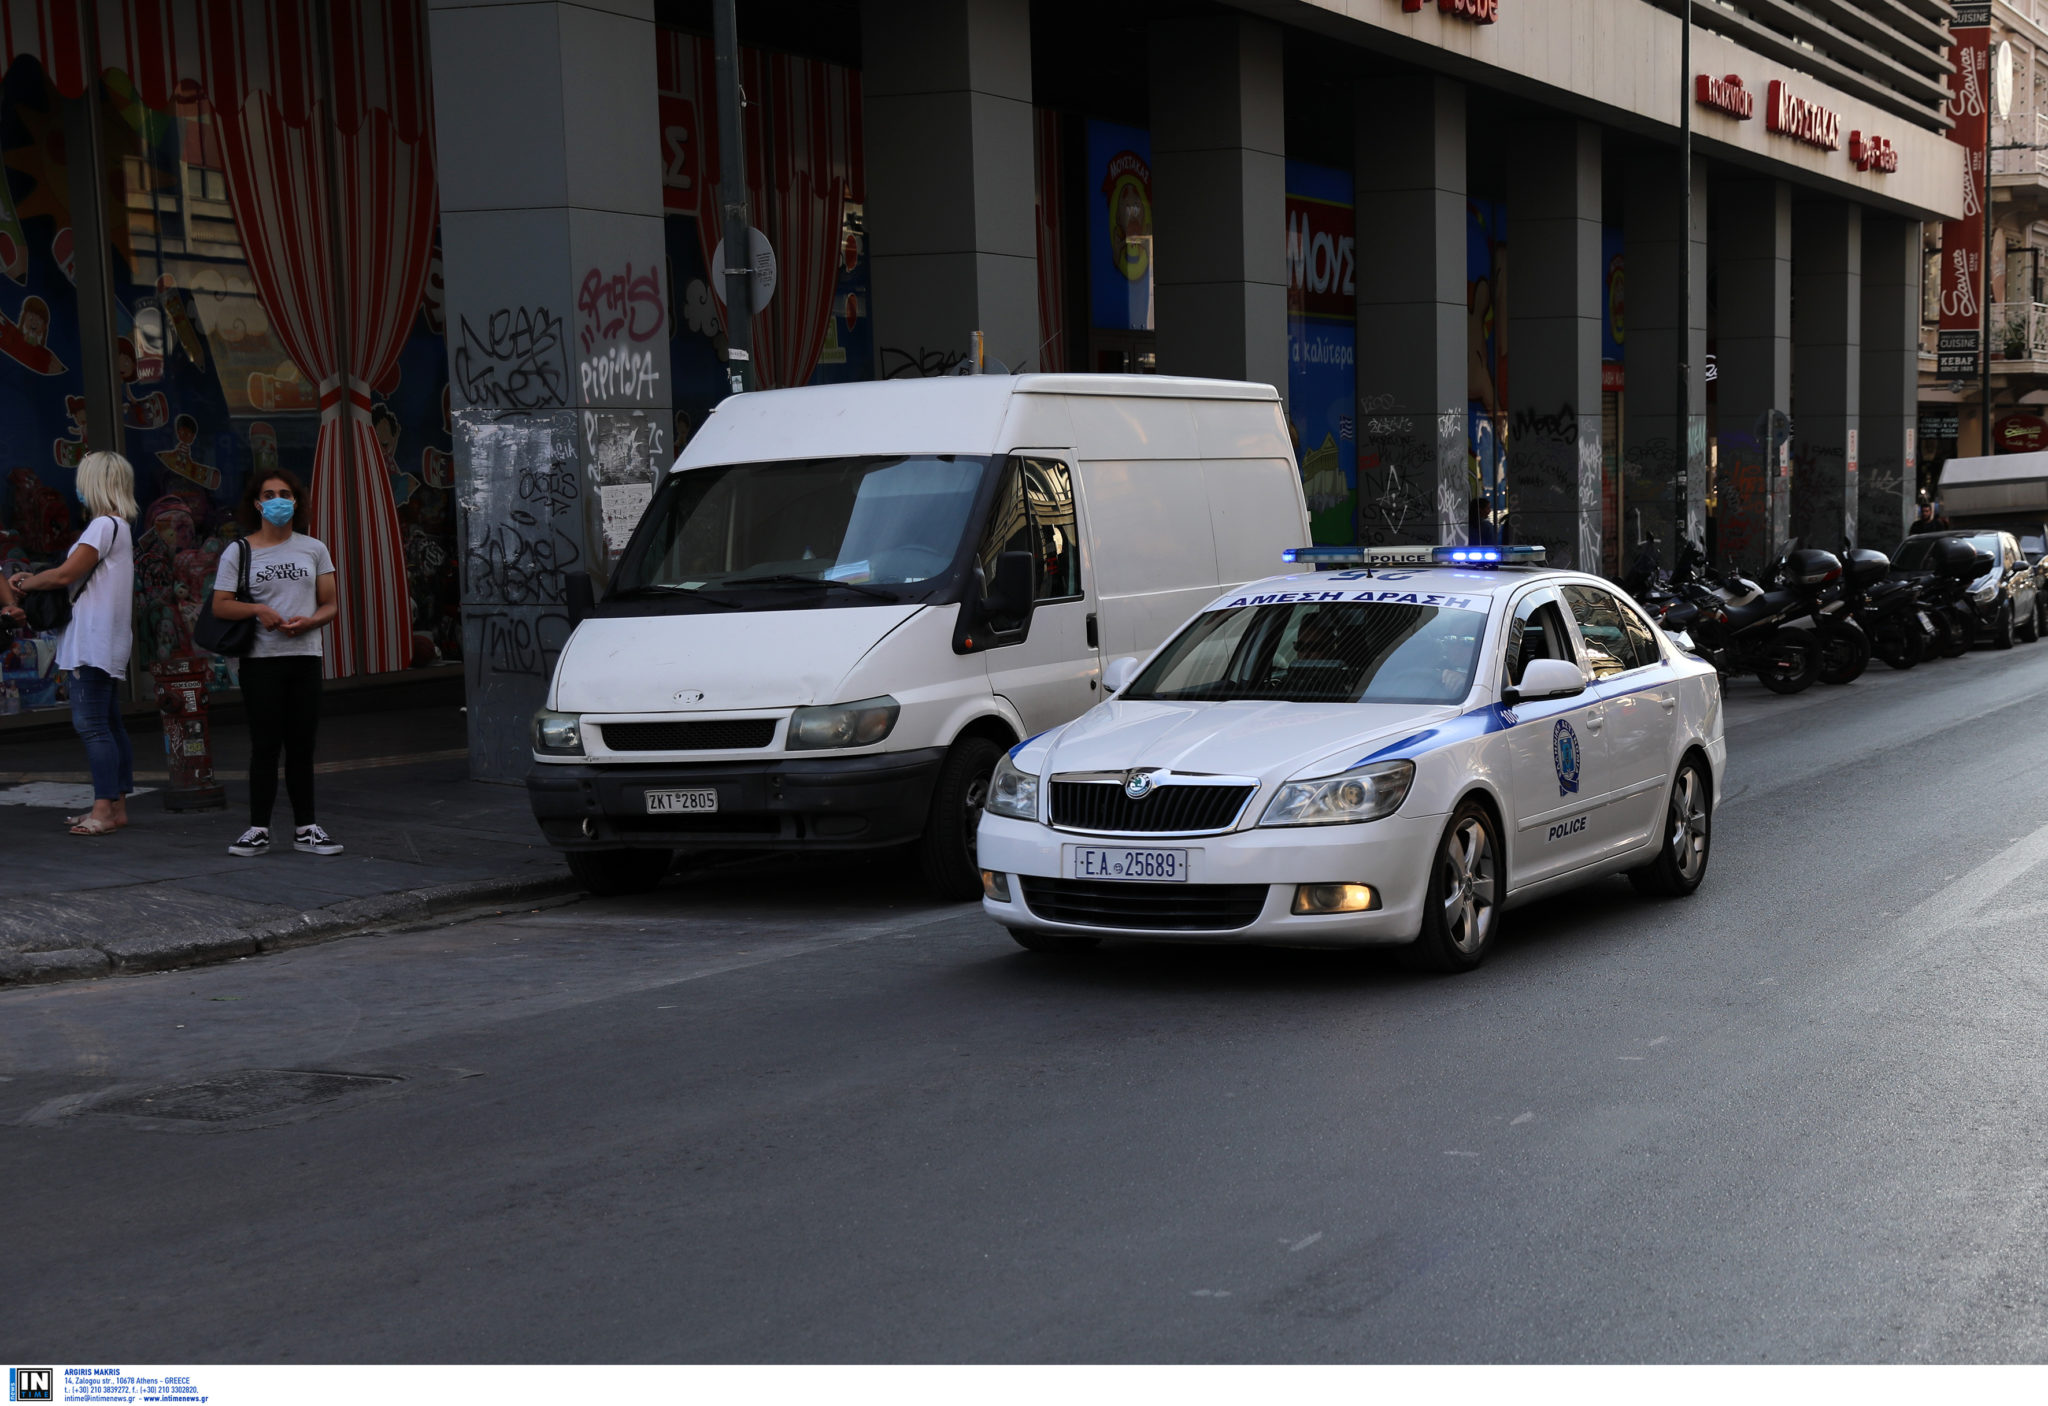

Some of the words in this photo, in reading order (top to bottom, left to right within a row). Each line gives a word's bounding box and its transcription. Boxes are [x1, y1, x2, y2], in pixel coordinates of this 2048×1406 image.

[662, 125, 693, 190] Σ
[1304, 336, 1354, 371] καλύτερα
[1940, 339, 1976, 348] CUISINE
[1940, 356, 1974, 366] KEBAP
[1227, 591, 1344, 607] ΑΜΕΣΗ
[1352, 591, 1472, 608] ΔΡΑΣΗ
[649, 794, 673, 809] ZKT
[681, 793, 715, 808] 2805
[1548, 816, 1587, 841] POLICE
[1125, 852, 1175, 877] 25689
